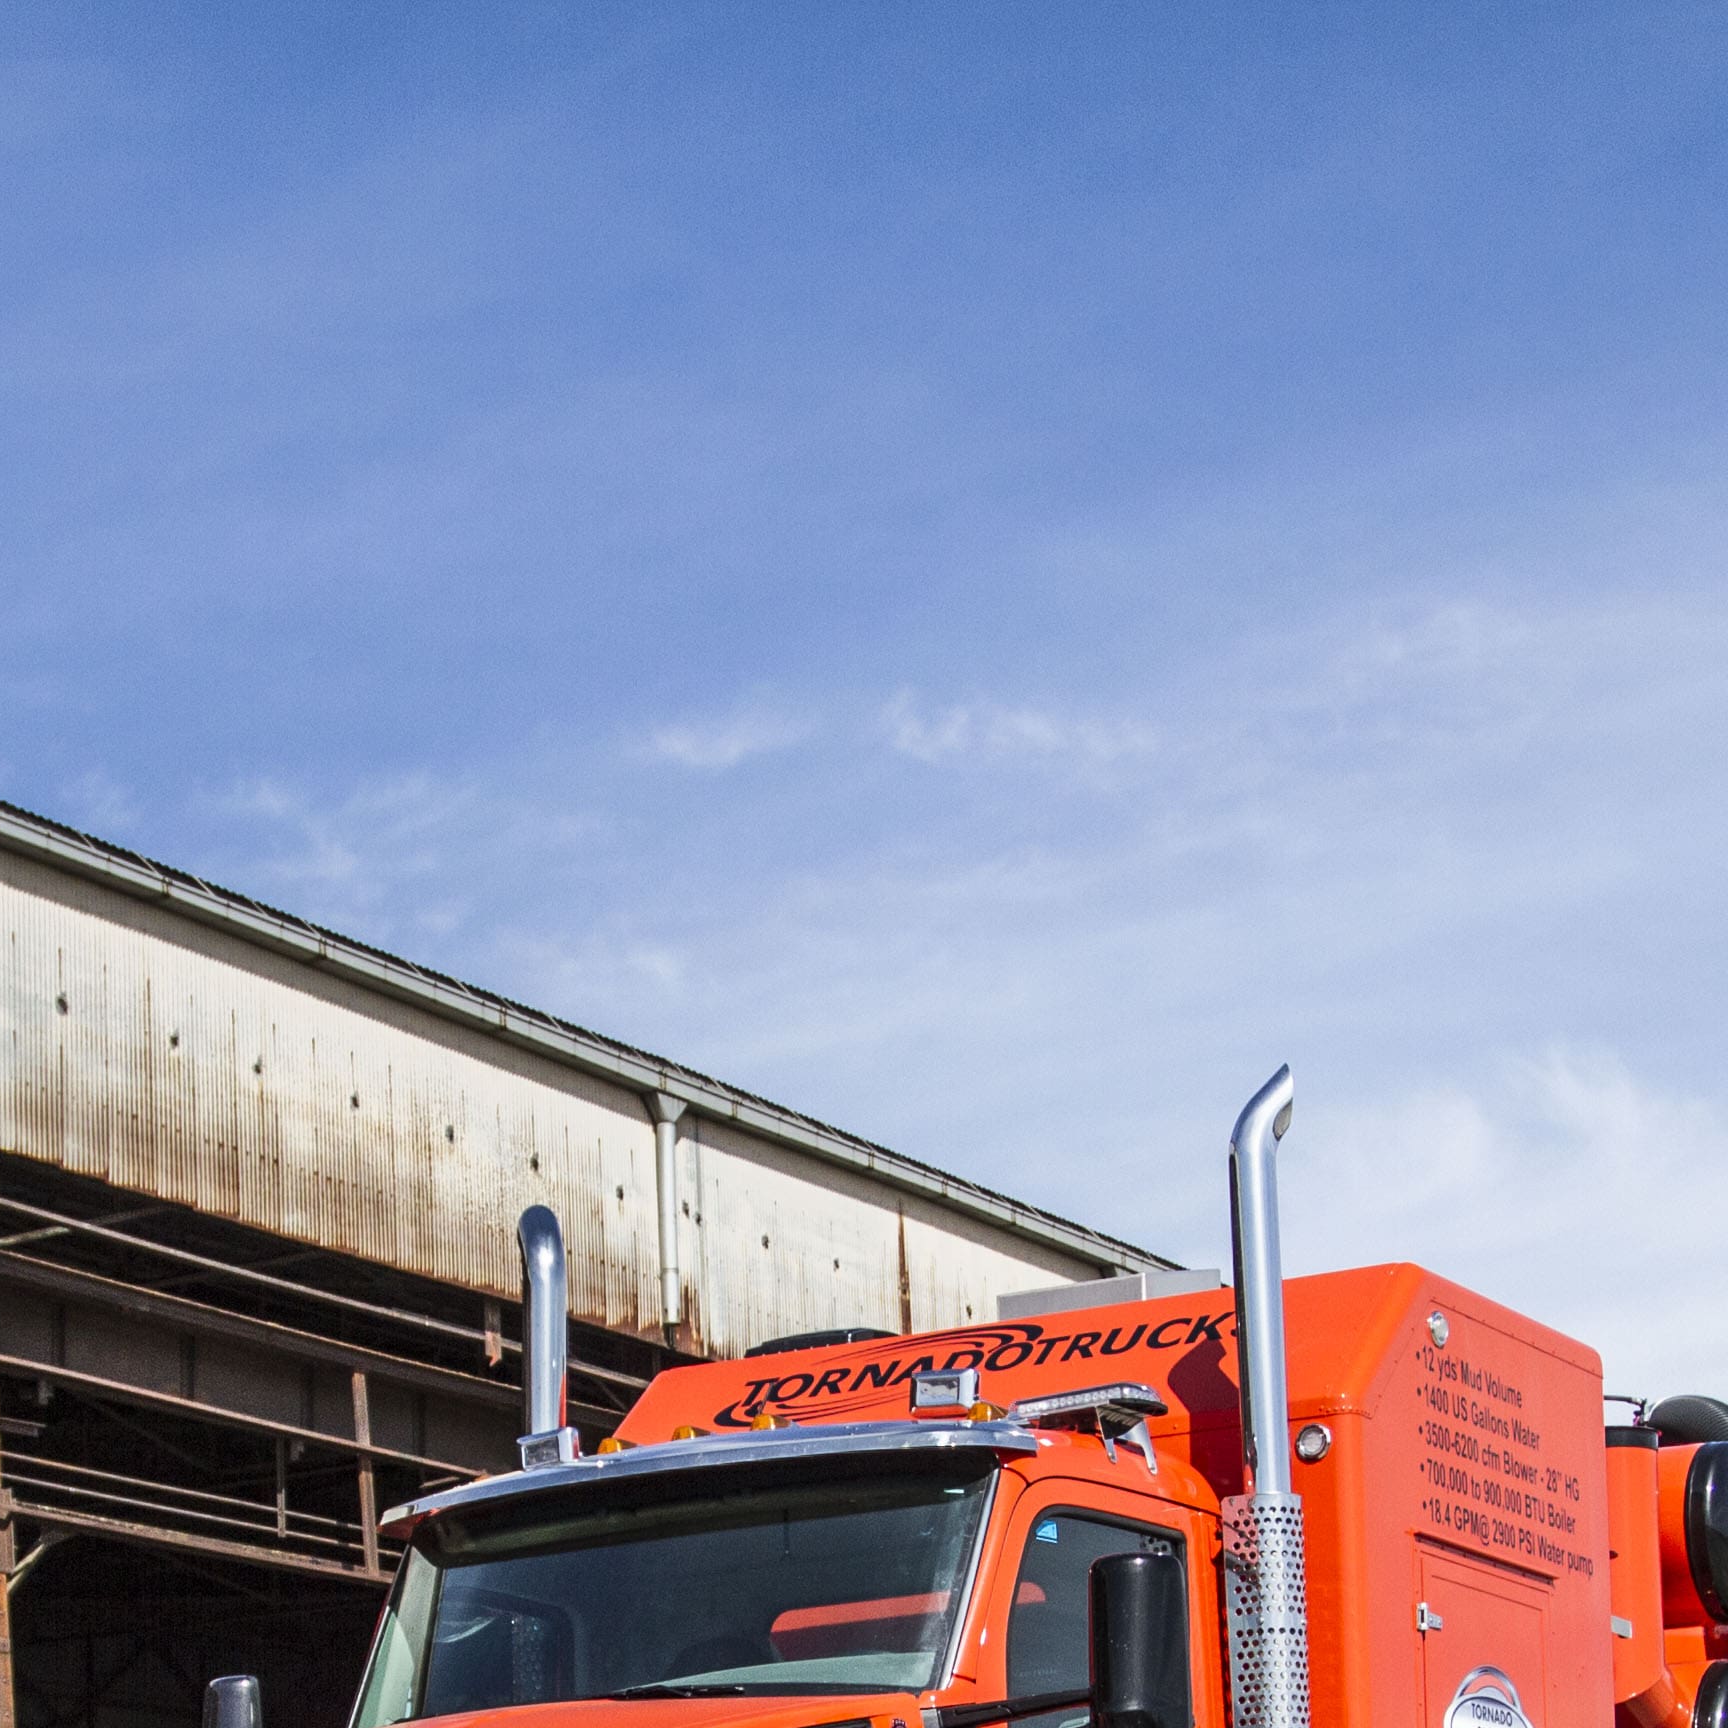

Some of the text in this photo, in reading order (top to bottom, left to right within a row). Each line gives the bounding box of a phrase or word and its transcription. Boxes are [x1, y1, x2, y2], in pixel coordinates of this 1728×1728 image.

[1422, 1346, 1523, 1408] 12 yds Mud Volume
[1424, 1383, 1540, 1450] 1400 US Gallons Water
[1425, 1420, 1479, 1463] 3500-6200
[1481, 1443, 1501, 1471] cfm
[1503, 1450, 1538, 1485] Blower
[1565, 1475, 1580, 1501] HG
[1427, 1458, 1576, 1535] 700,000 to 900,000 BTU Boiler
[1429, 1497, 1451, 1527] 18.4
[1492, 1519, 1516, 1549] 2900
[1518, 1528, 1536, 1555] PSI
[1537, 1535, 1565, 1566] Water
[1567, 1551, 1594, 1577] pump
[1471, 1702, 1513, 1727] TORNADO
